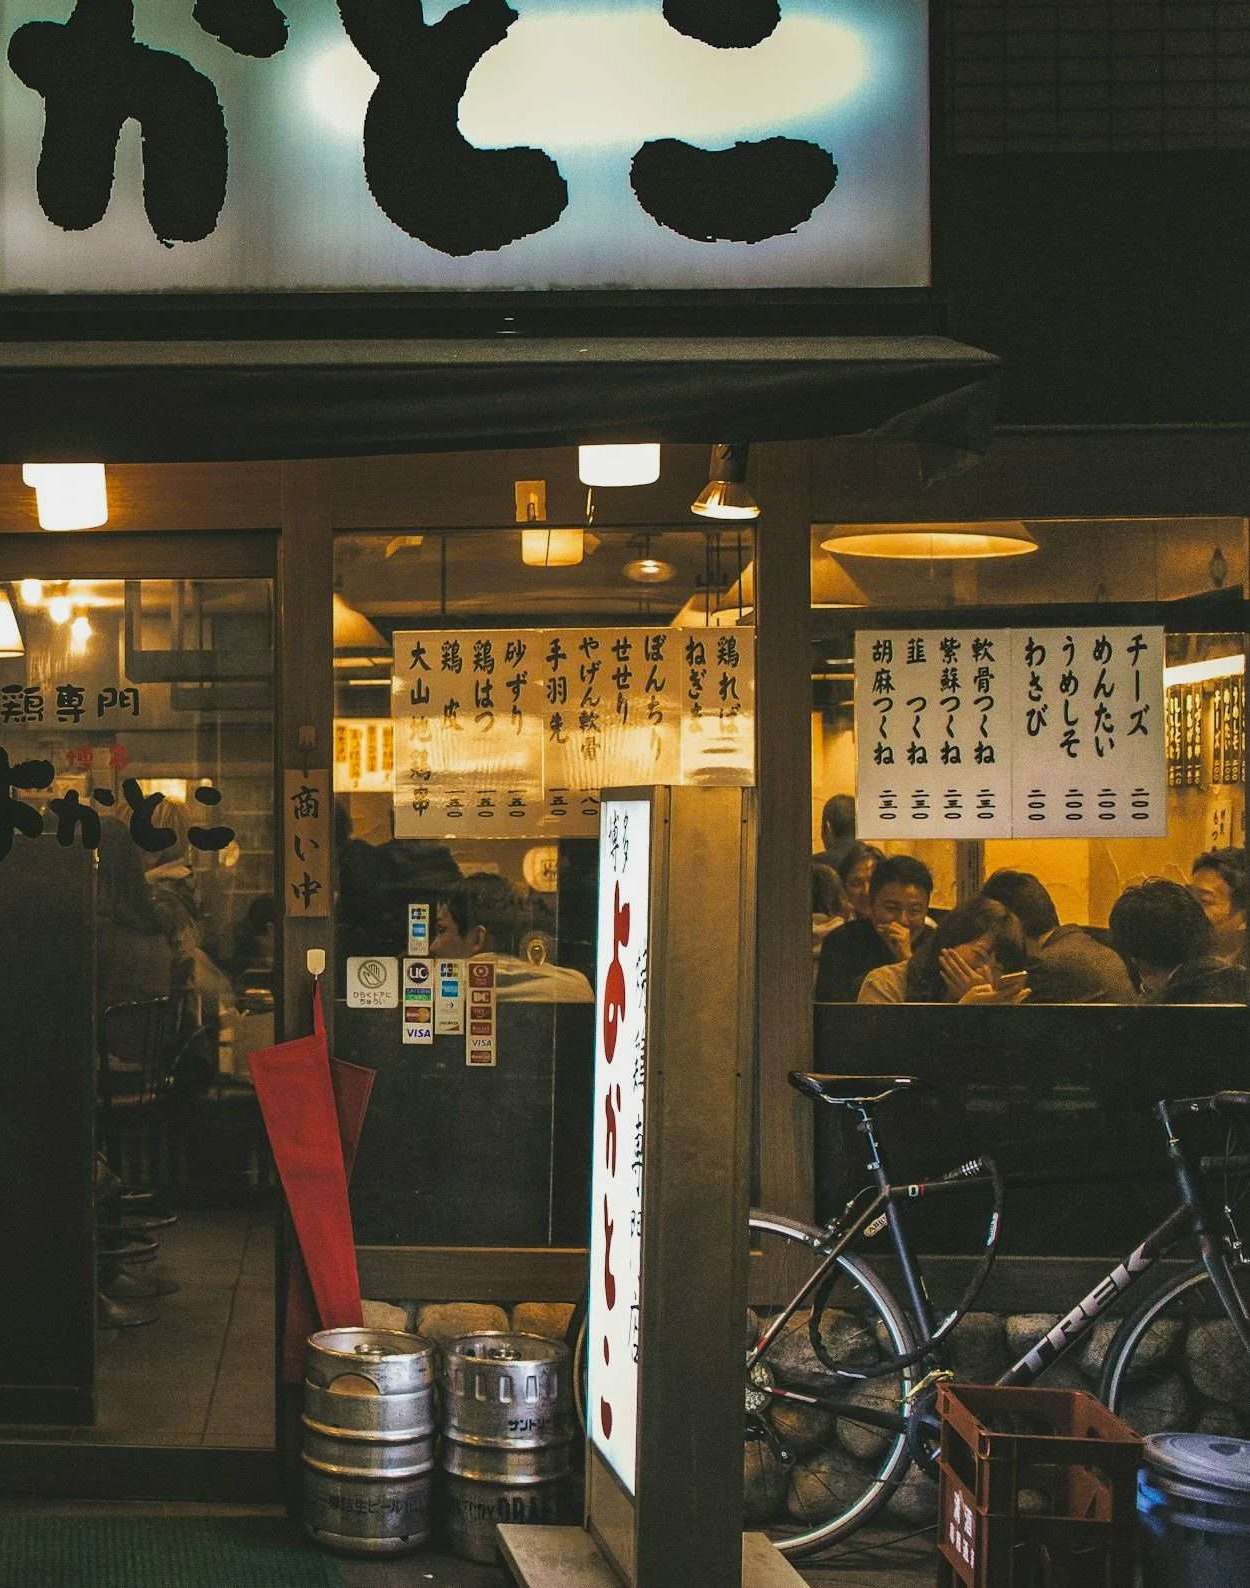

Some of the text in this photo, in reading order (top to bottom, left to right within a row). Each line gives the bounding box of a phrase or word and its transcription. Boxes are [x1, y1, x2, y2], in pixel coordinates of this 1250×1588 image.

[473, 640, 495, 733] 鶏はつ
[504, 639, 528, 736] 砂ずり
[545, 638, 569, 744] 手羽先
[578, 637, 602, 761] やげん軟骨
[611, 635, 633, 726] せせり
[871, 639, 896, 765] 胡麻つくね
[906, 637, 929, 765] 韮つくね
[939, 637, 962, 765] 紫蘇つくね
[971, 636, 996, 765] 軟骨つくね
[1024, 636, 1048, 737] わさび
[1059, 635, 1080, 758] うめしそ
[1092, 634, 1115, 758] めんたい
[1127, 634, 1150, 737] チーズ
[291, 785, 323, 910] 商い中
[406, 1029, 431, 1038] VISA
[409, 967, 429, 979] UC
[472, 1039, 492, 1047] VISA
[601, 879, 631, 1441] よかとこ
[1011, 1242, 1150, 1374] TREK
